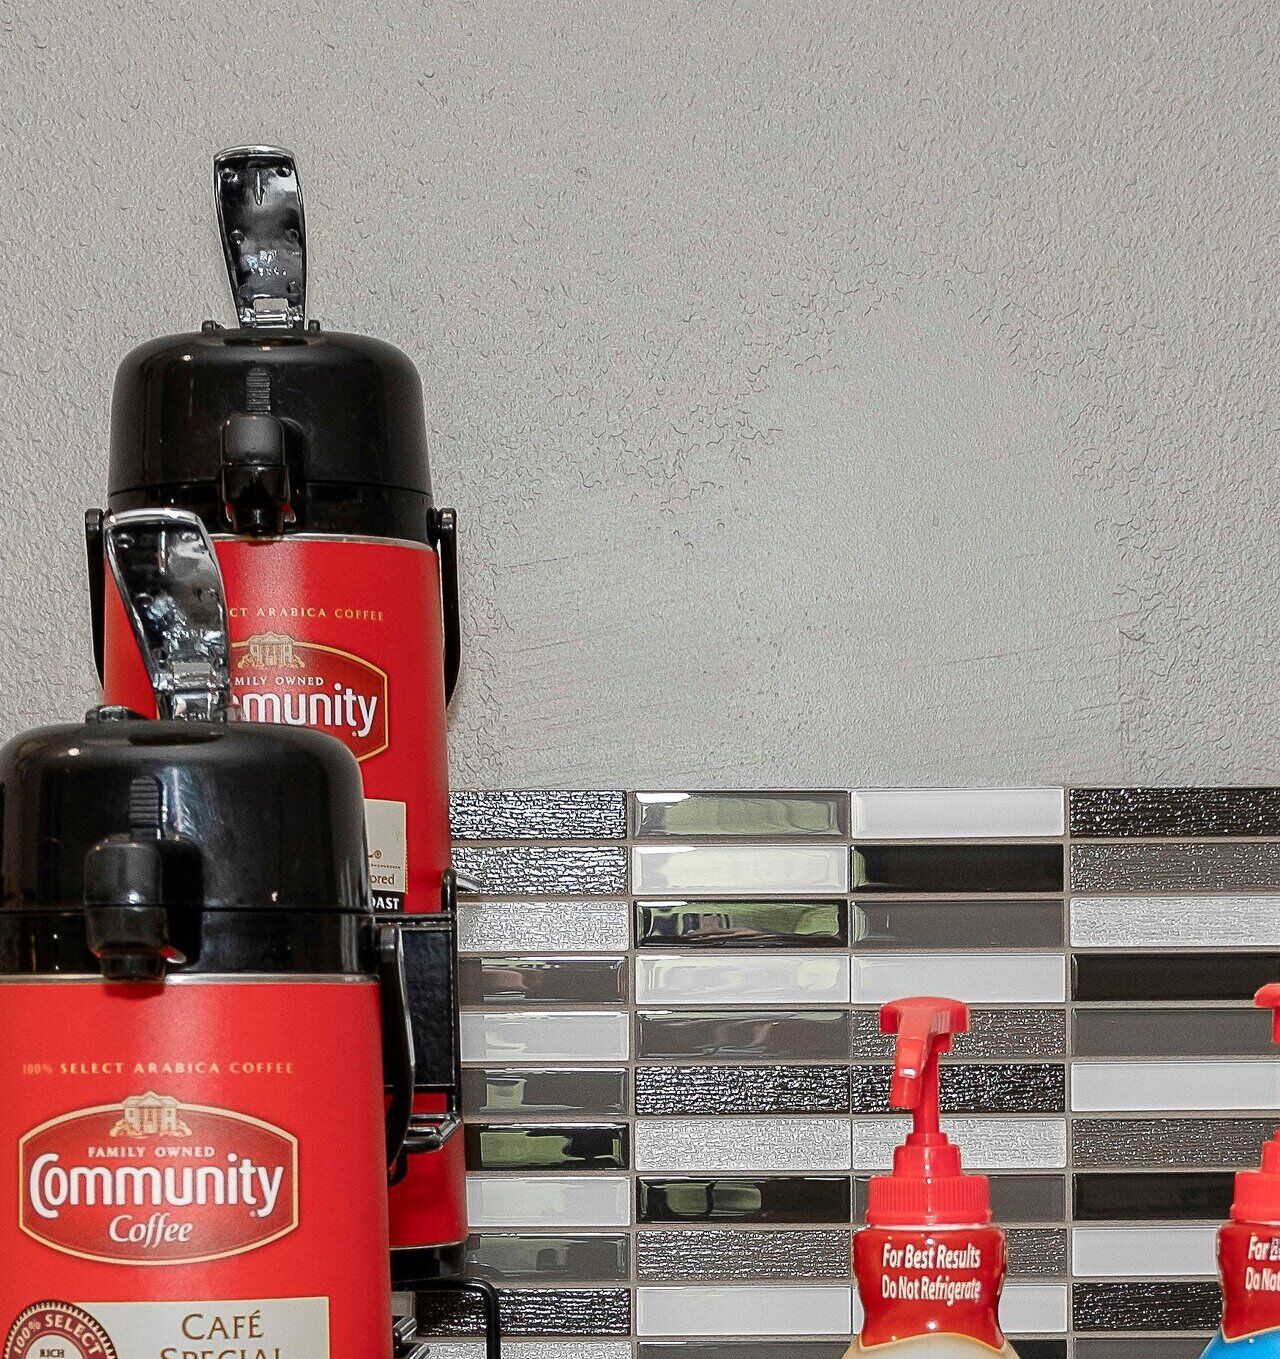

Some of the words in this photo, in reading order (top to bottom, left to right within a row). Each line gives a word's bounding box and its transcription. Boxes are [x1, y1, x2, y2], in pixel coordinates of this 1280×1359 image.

[256, 607, 327, 618] ARABICA
[334, 608, 384, 621] COFFEE
[234, 676, 267, 686] MILY
[275, 676, 324, 686] OWNED
[22, 1063, 54, 1074] 100%
[59, 1062, 125, 1074] SELECT
[133, 1062, 220, 1074] ARABICA
[228, 1062, 294, 1075] COFFEE
[87, 1146, 146, 1158] FAMILY
[154, 1146, 216, 1158] OWNED
[29, 1152, 284, 1218] Community
[108, 1211, 193, 1248] Coffee
[882, 1242, 904, 1268] For
[904, 1243, 935, 1269] Best
[936, 1242, 981, 1269] Results
[1247, 1234, 1269, 1260] For
[881, 1274, 897, 1299] Do
[898, 1275, 920, 1300] Not
[920, 1274, 981, 1306] Refrigerate
[1245, 1266, 1261, 1290] Do
[13, 1319, 42, 1354] 100%
[44, 1313, 103, 1354] SELECT
[181, 1309, 264, 1341] CAFÉ
[39, 1348, 65, 1358] RICH
